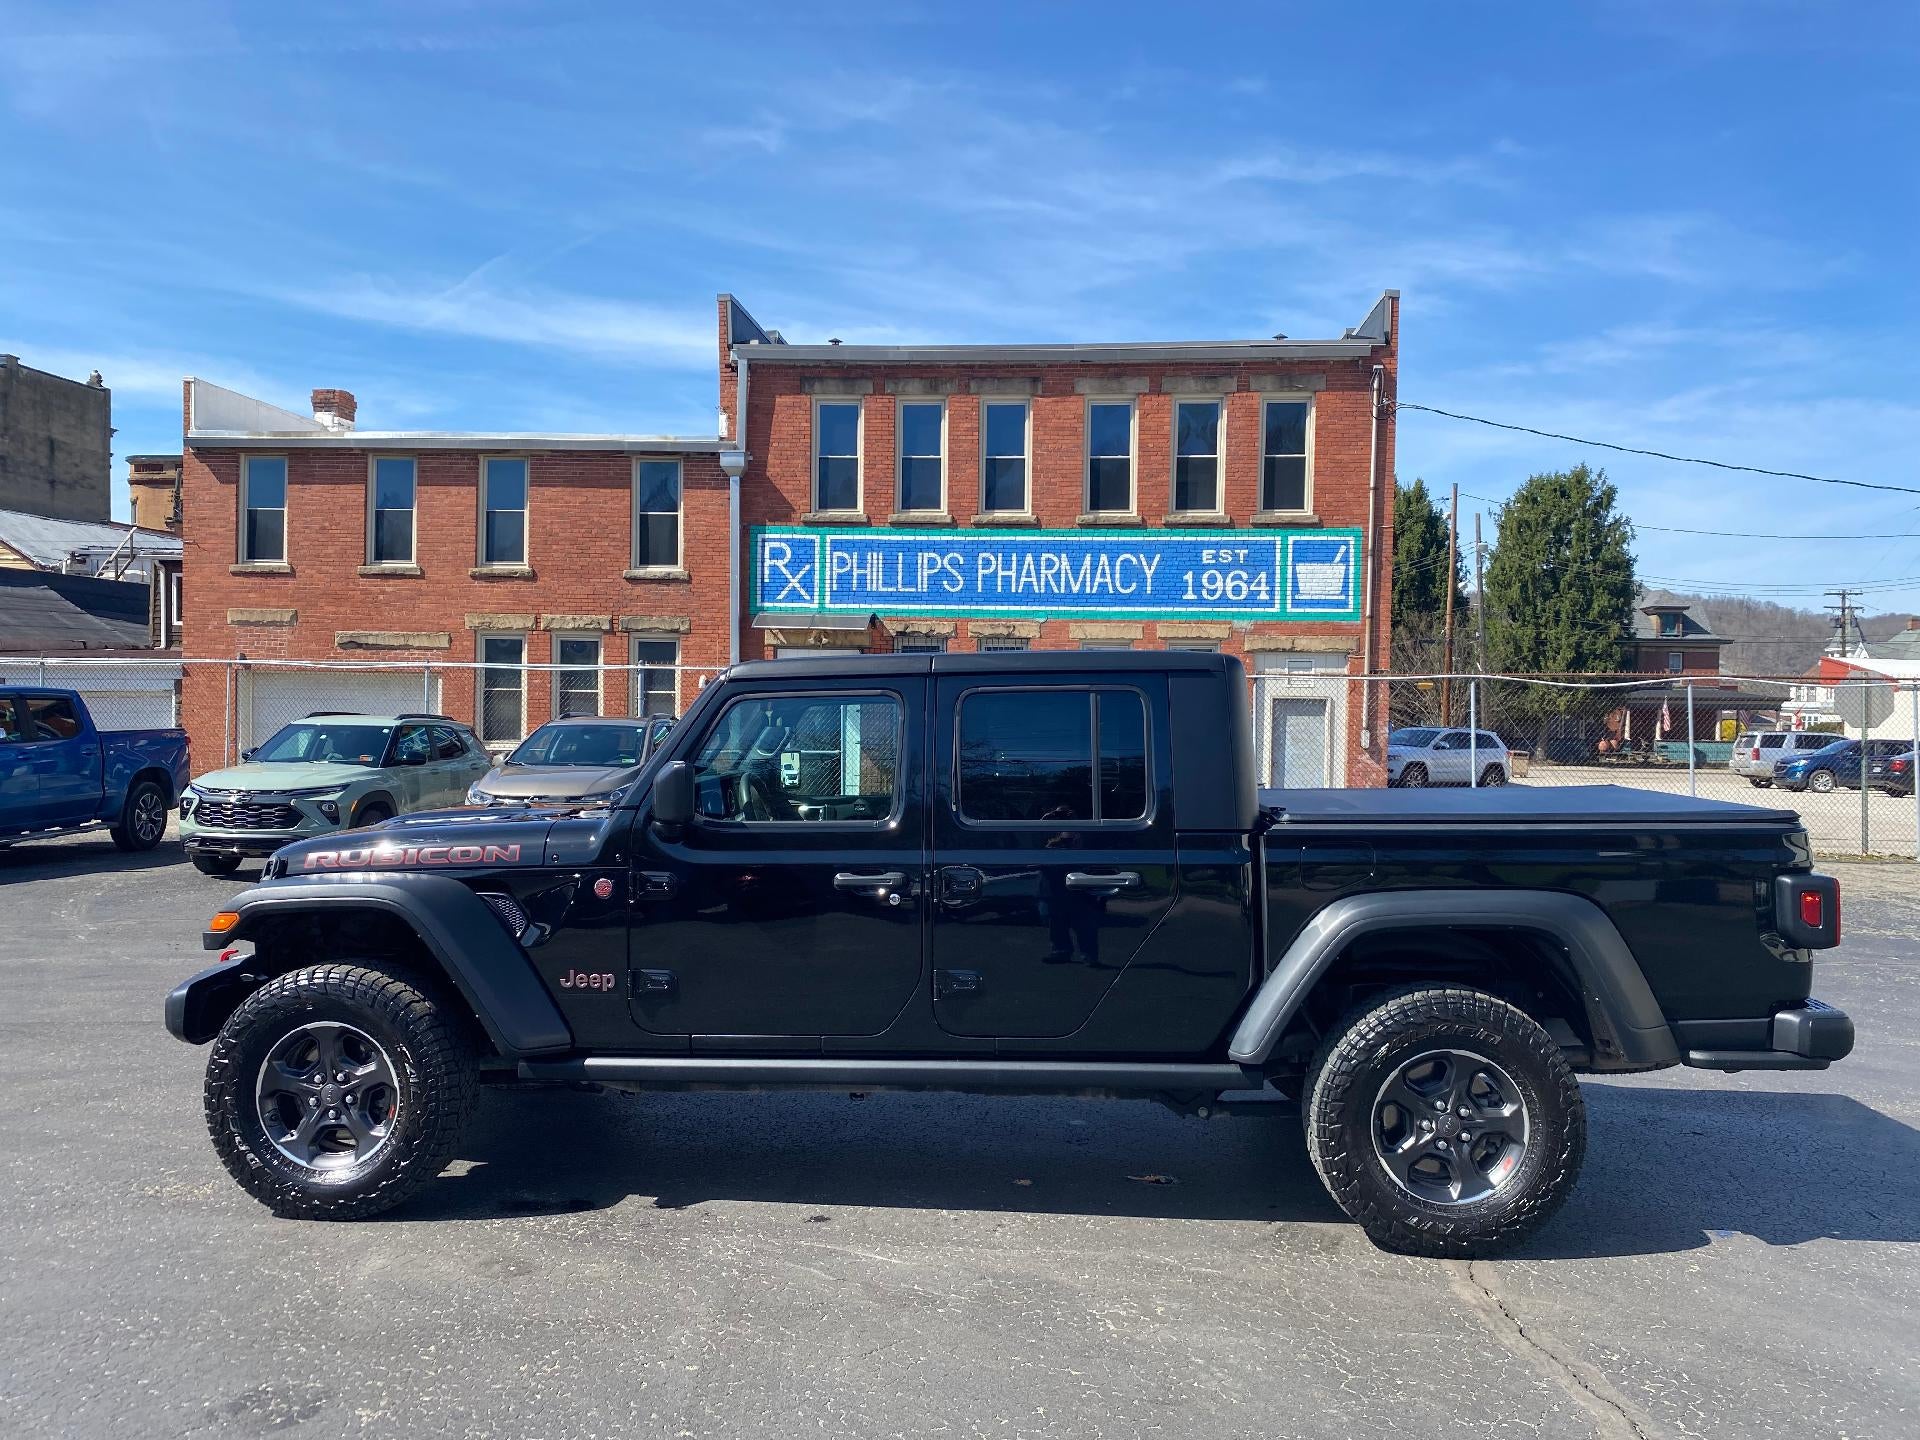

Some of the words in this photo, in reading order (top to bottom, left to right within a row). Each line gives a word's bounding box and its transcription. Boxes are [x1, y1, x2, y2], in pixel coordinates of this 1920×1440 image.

[1202, 550, 1249, 564] EST
[832, 551, 964, 593] PHILLIPS
[977, 552, 1161, 594] PHARMACY
[1182, 570, 1270, 600] 1964
[303, 844, 521, 869] RUBICON
[559, 969, 616, 992] Jeep
